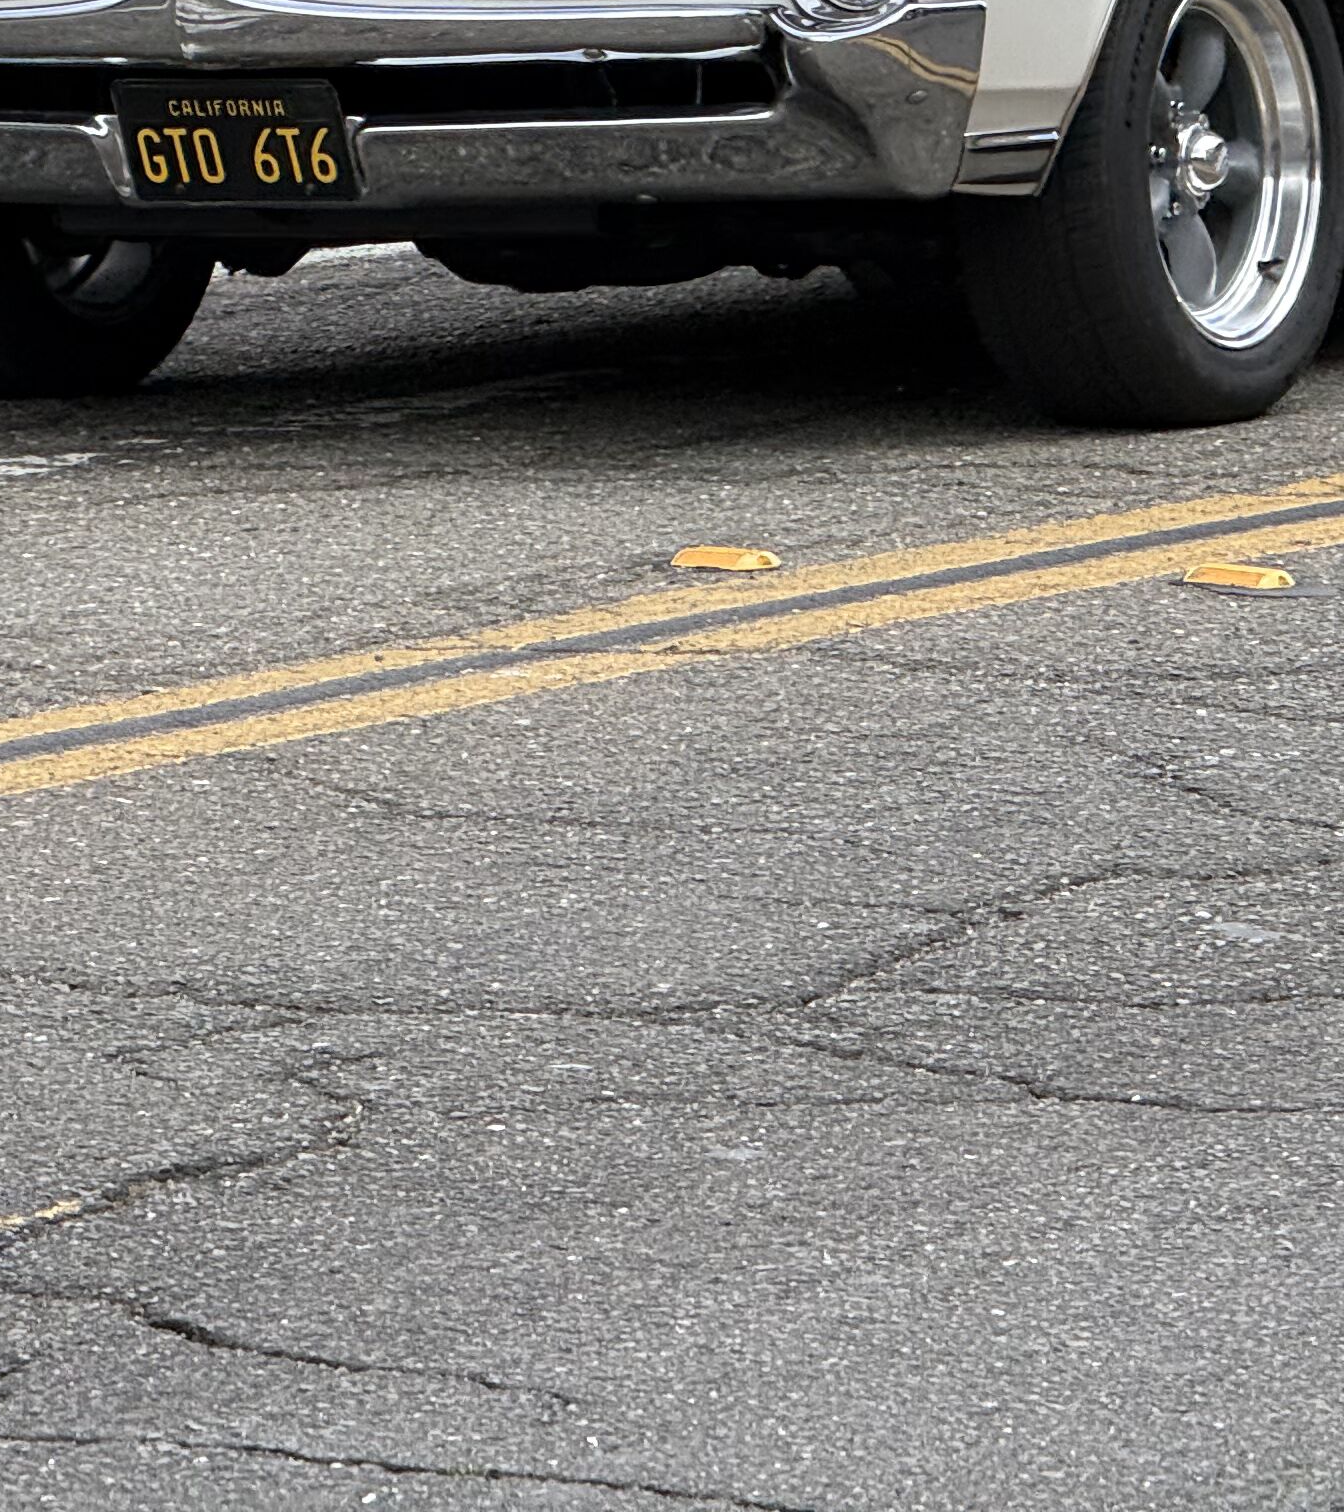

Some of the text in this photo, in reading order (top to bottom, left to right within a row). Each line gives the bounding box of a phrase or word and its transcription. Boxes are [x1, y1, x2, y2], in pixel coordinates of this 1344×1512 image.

[167, 99, 286, 117] CALIFORNIA
[136, 127, 339, 185] GTO 6T6
